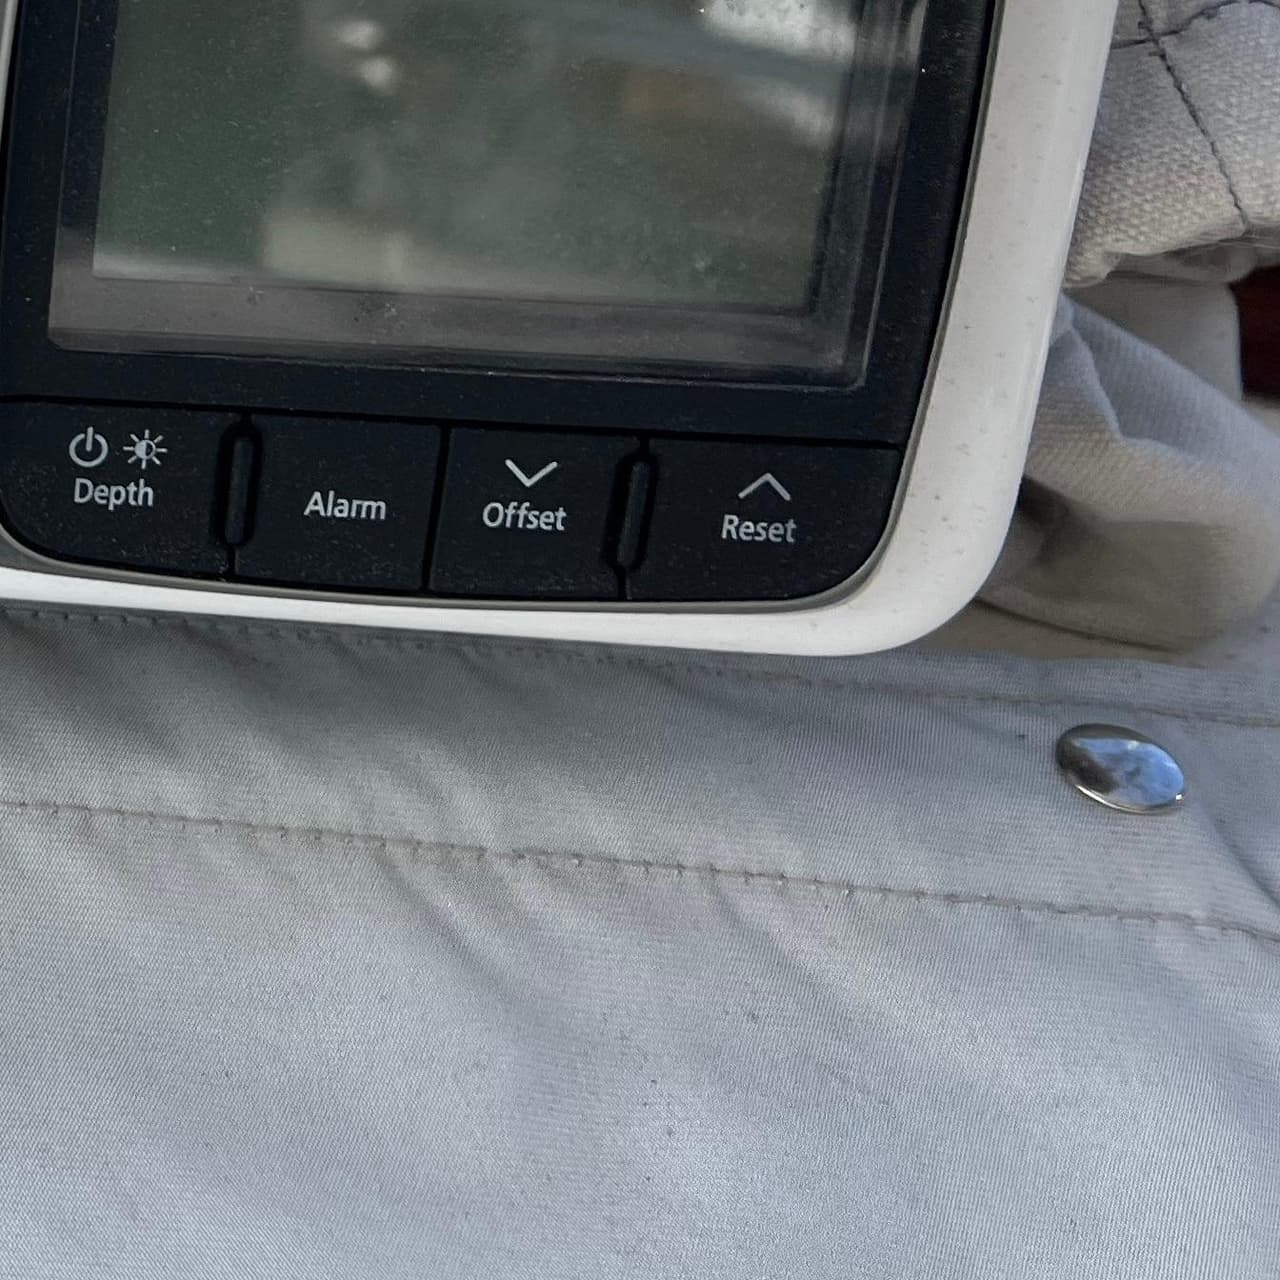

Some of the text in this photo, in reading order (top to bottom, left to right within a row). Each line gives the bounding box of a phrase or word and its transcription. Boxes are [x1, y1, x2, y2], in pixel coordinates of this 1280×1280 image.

[74, 477, 154, 511] Depth
[303, 490, 386, 520] Alarm
[482, 501, 567, 531] Offset
[721, 514, 797, 543] Reset
